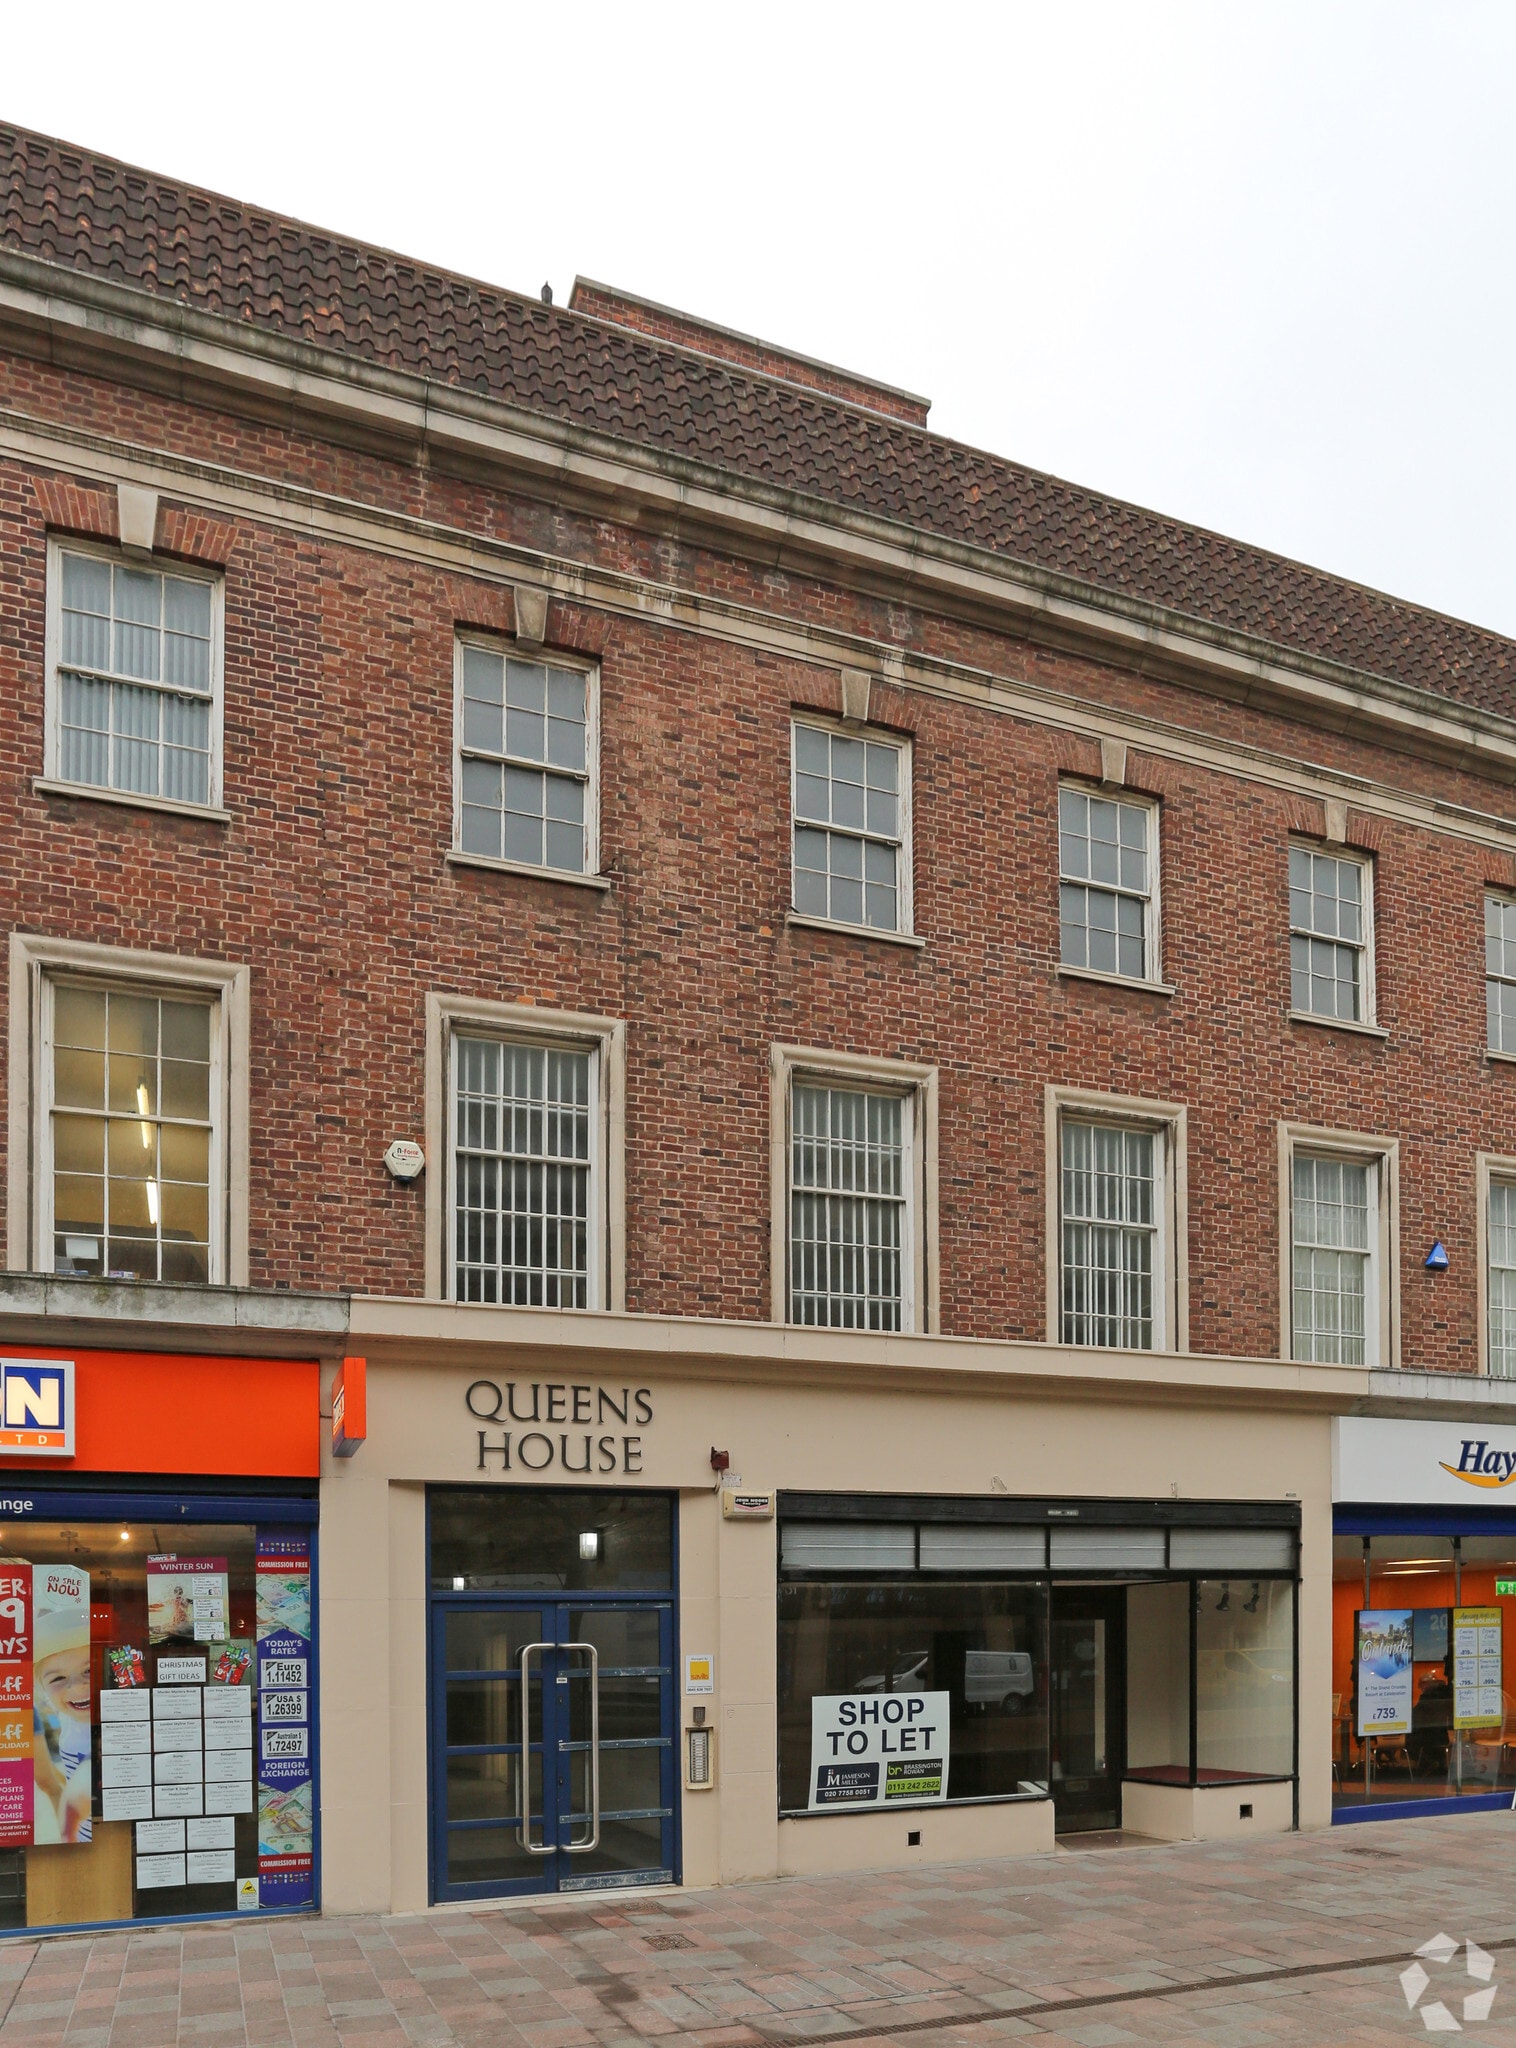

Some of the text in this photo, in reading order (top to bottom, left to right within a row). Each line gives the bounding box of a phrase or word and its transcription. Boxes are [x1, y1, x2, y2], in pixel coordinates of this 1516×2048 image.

[0, 1376, 59, 1426] N
[466, 1380, 653, 1426] QUEENS
[0, 1434, 48, 1445] TD
[476, 1430, 643, 1474] HOUSE
[0, 1500, 33, 1514] nge
[47, 1582, 80, 1596] NOW
[62, 1578, 81, 1586] SALE
[1362, 1639, 1412, 1662] Orlando
[267, 1671, 302, 1682] 1.11452
[267, 1704, 302, 1715] 1.26399
[838, 1699, 925, 1726] SHOP
[268, 1741, 302, 1751] 1.72497
[826, 1727, 936, 1756] TO LET
[261, 1769, 310, 1778] EXCHANGE
